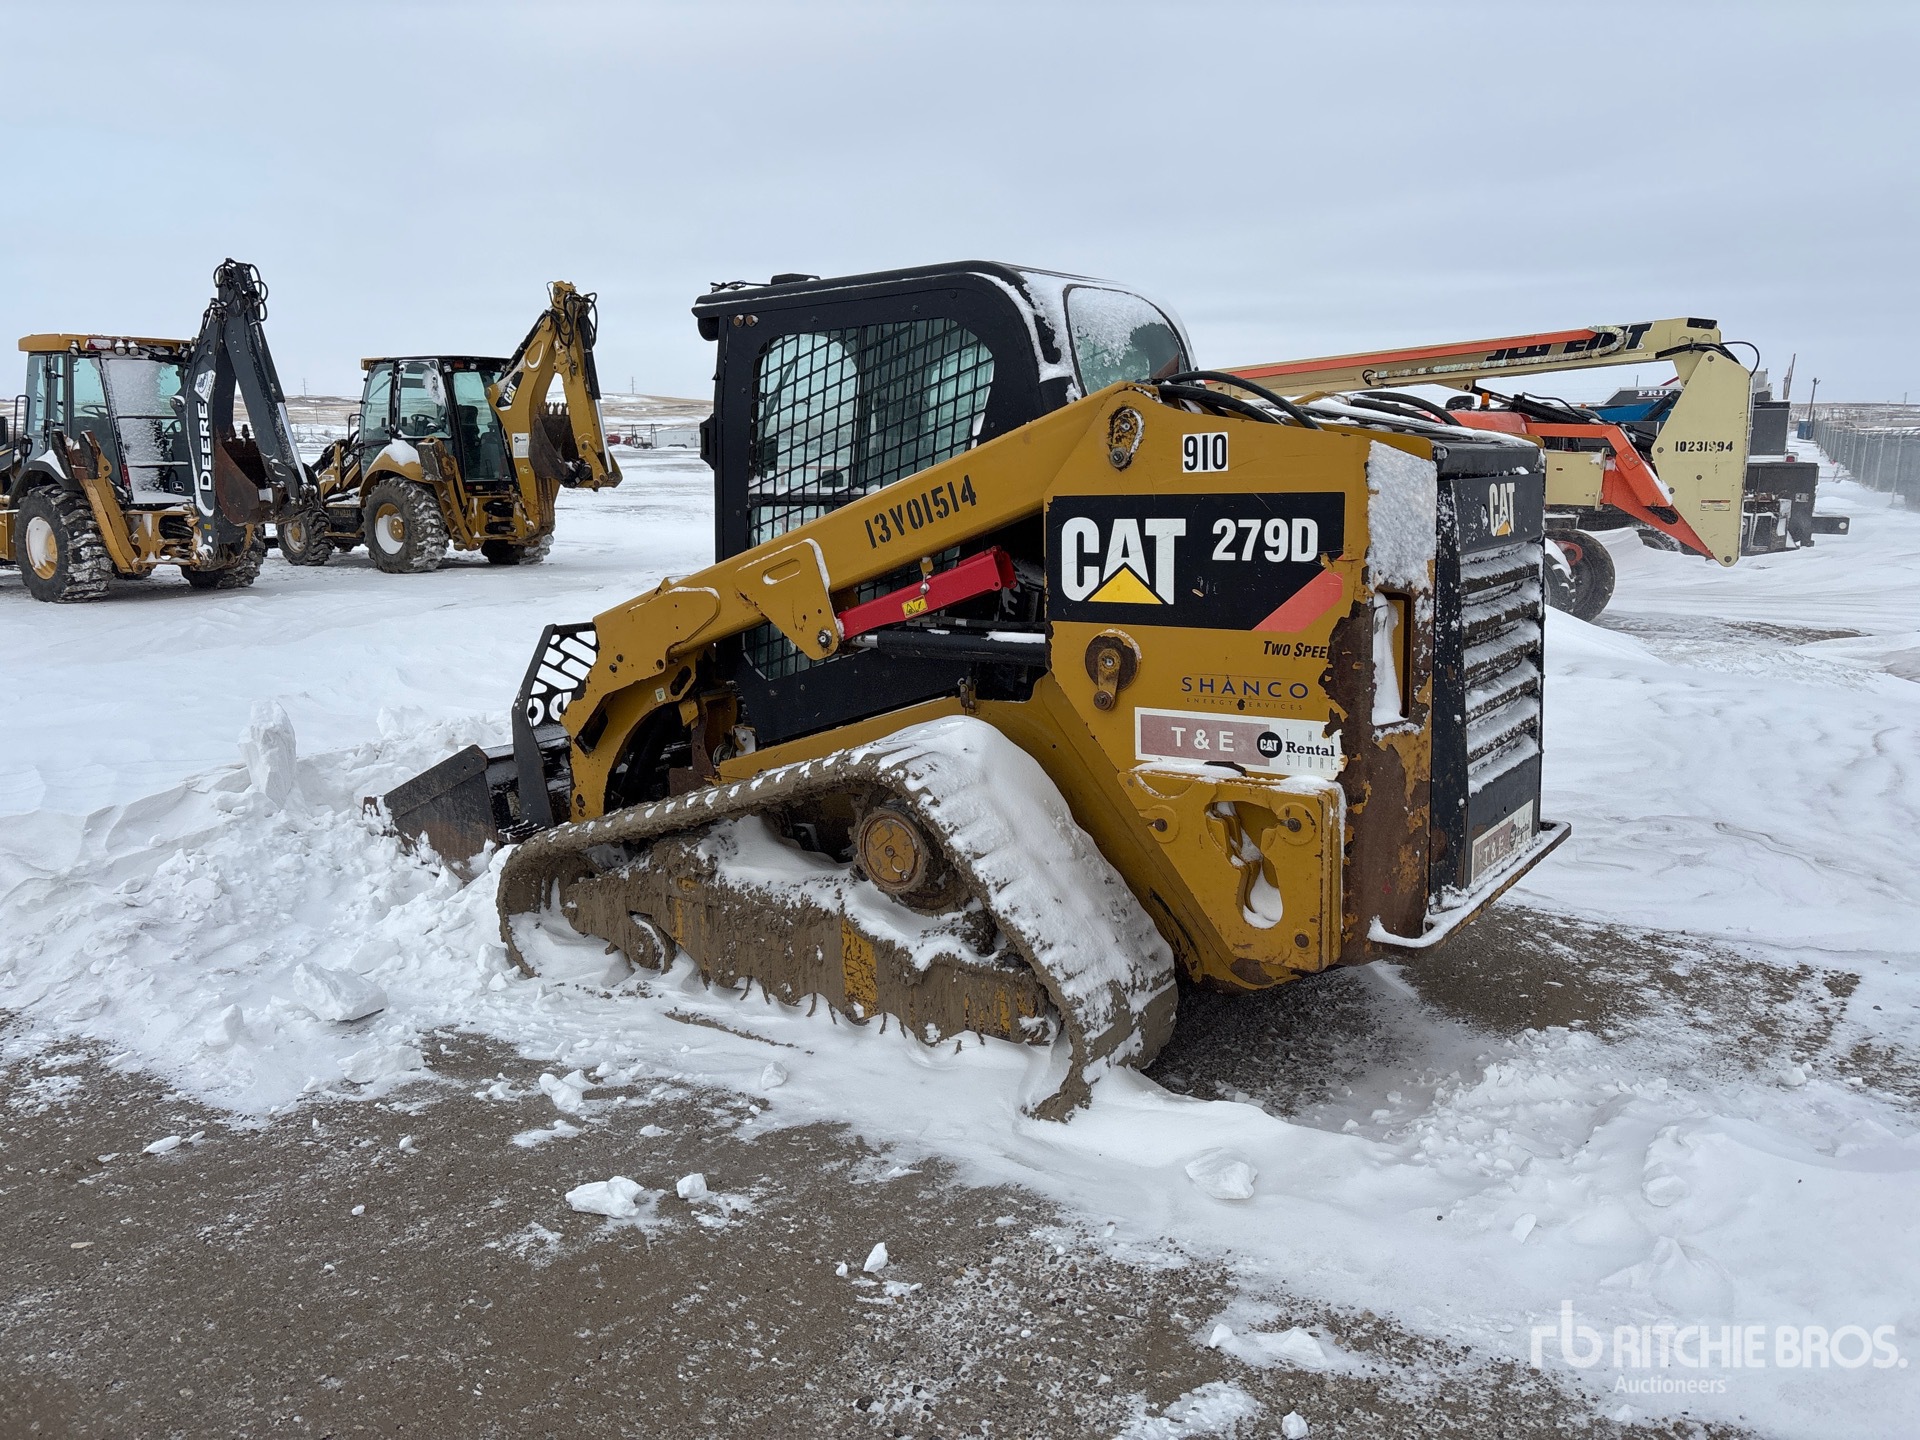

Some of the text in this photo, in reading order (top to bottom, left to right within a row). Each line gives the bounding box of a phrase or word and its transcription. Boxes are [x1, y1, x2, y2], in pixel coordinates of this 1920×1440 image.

[504, 380, 518, 403] CAT
[197, 401, 213, 491] DEERE
[1184, 434, 1227, 471] 910
[1489, 482, 1515, 536] CAT
[1061, 517, 1319, 605] CAT 279D
[1264, 641, 1328, 659] TWO SPEE
[1181, 676, 1309, 699] SHANCO
[1186, 697, 1303, 711] ENERGY ERVICES
[1171, 727, 1235, 752] T & E
[1259, 738, 1336, 757] CAT Rental
[1286, 754, 1335, 770] STORE
